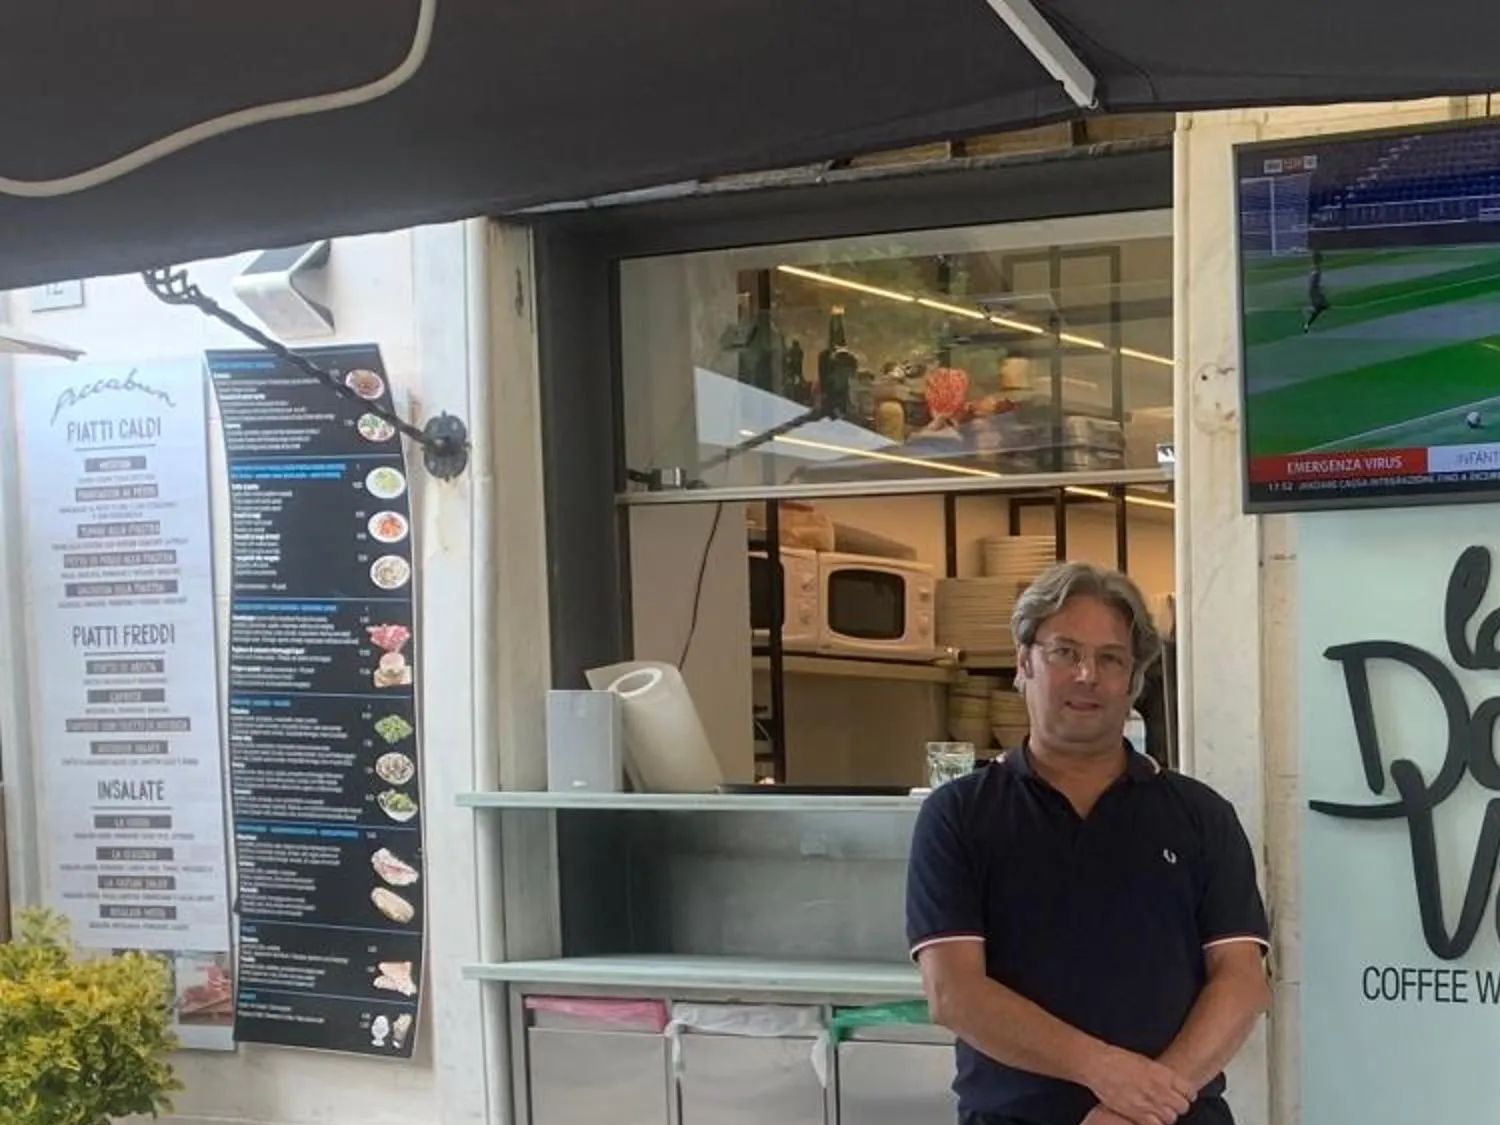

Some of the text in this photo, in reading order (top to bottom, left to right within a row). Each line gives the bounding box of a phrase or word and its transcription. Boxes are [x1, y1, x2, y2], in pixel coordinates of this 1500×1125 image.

[67, 416, 161, 442] PIATTI CALDI
[1287, 456, 1403, 475] EMERGENZA VIRUS
[72, 623, 175, 647] PIATTI FREDDI
[98, 780, 164, 800] INSALATE
[1362, 966, 1468, 1003] COFFEE
